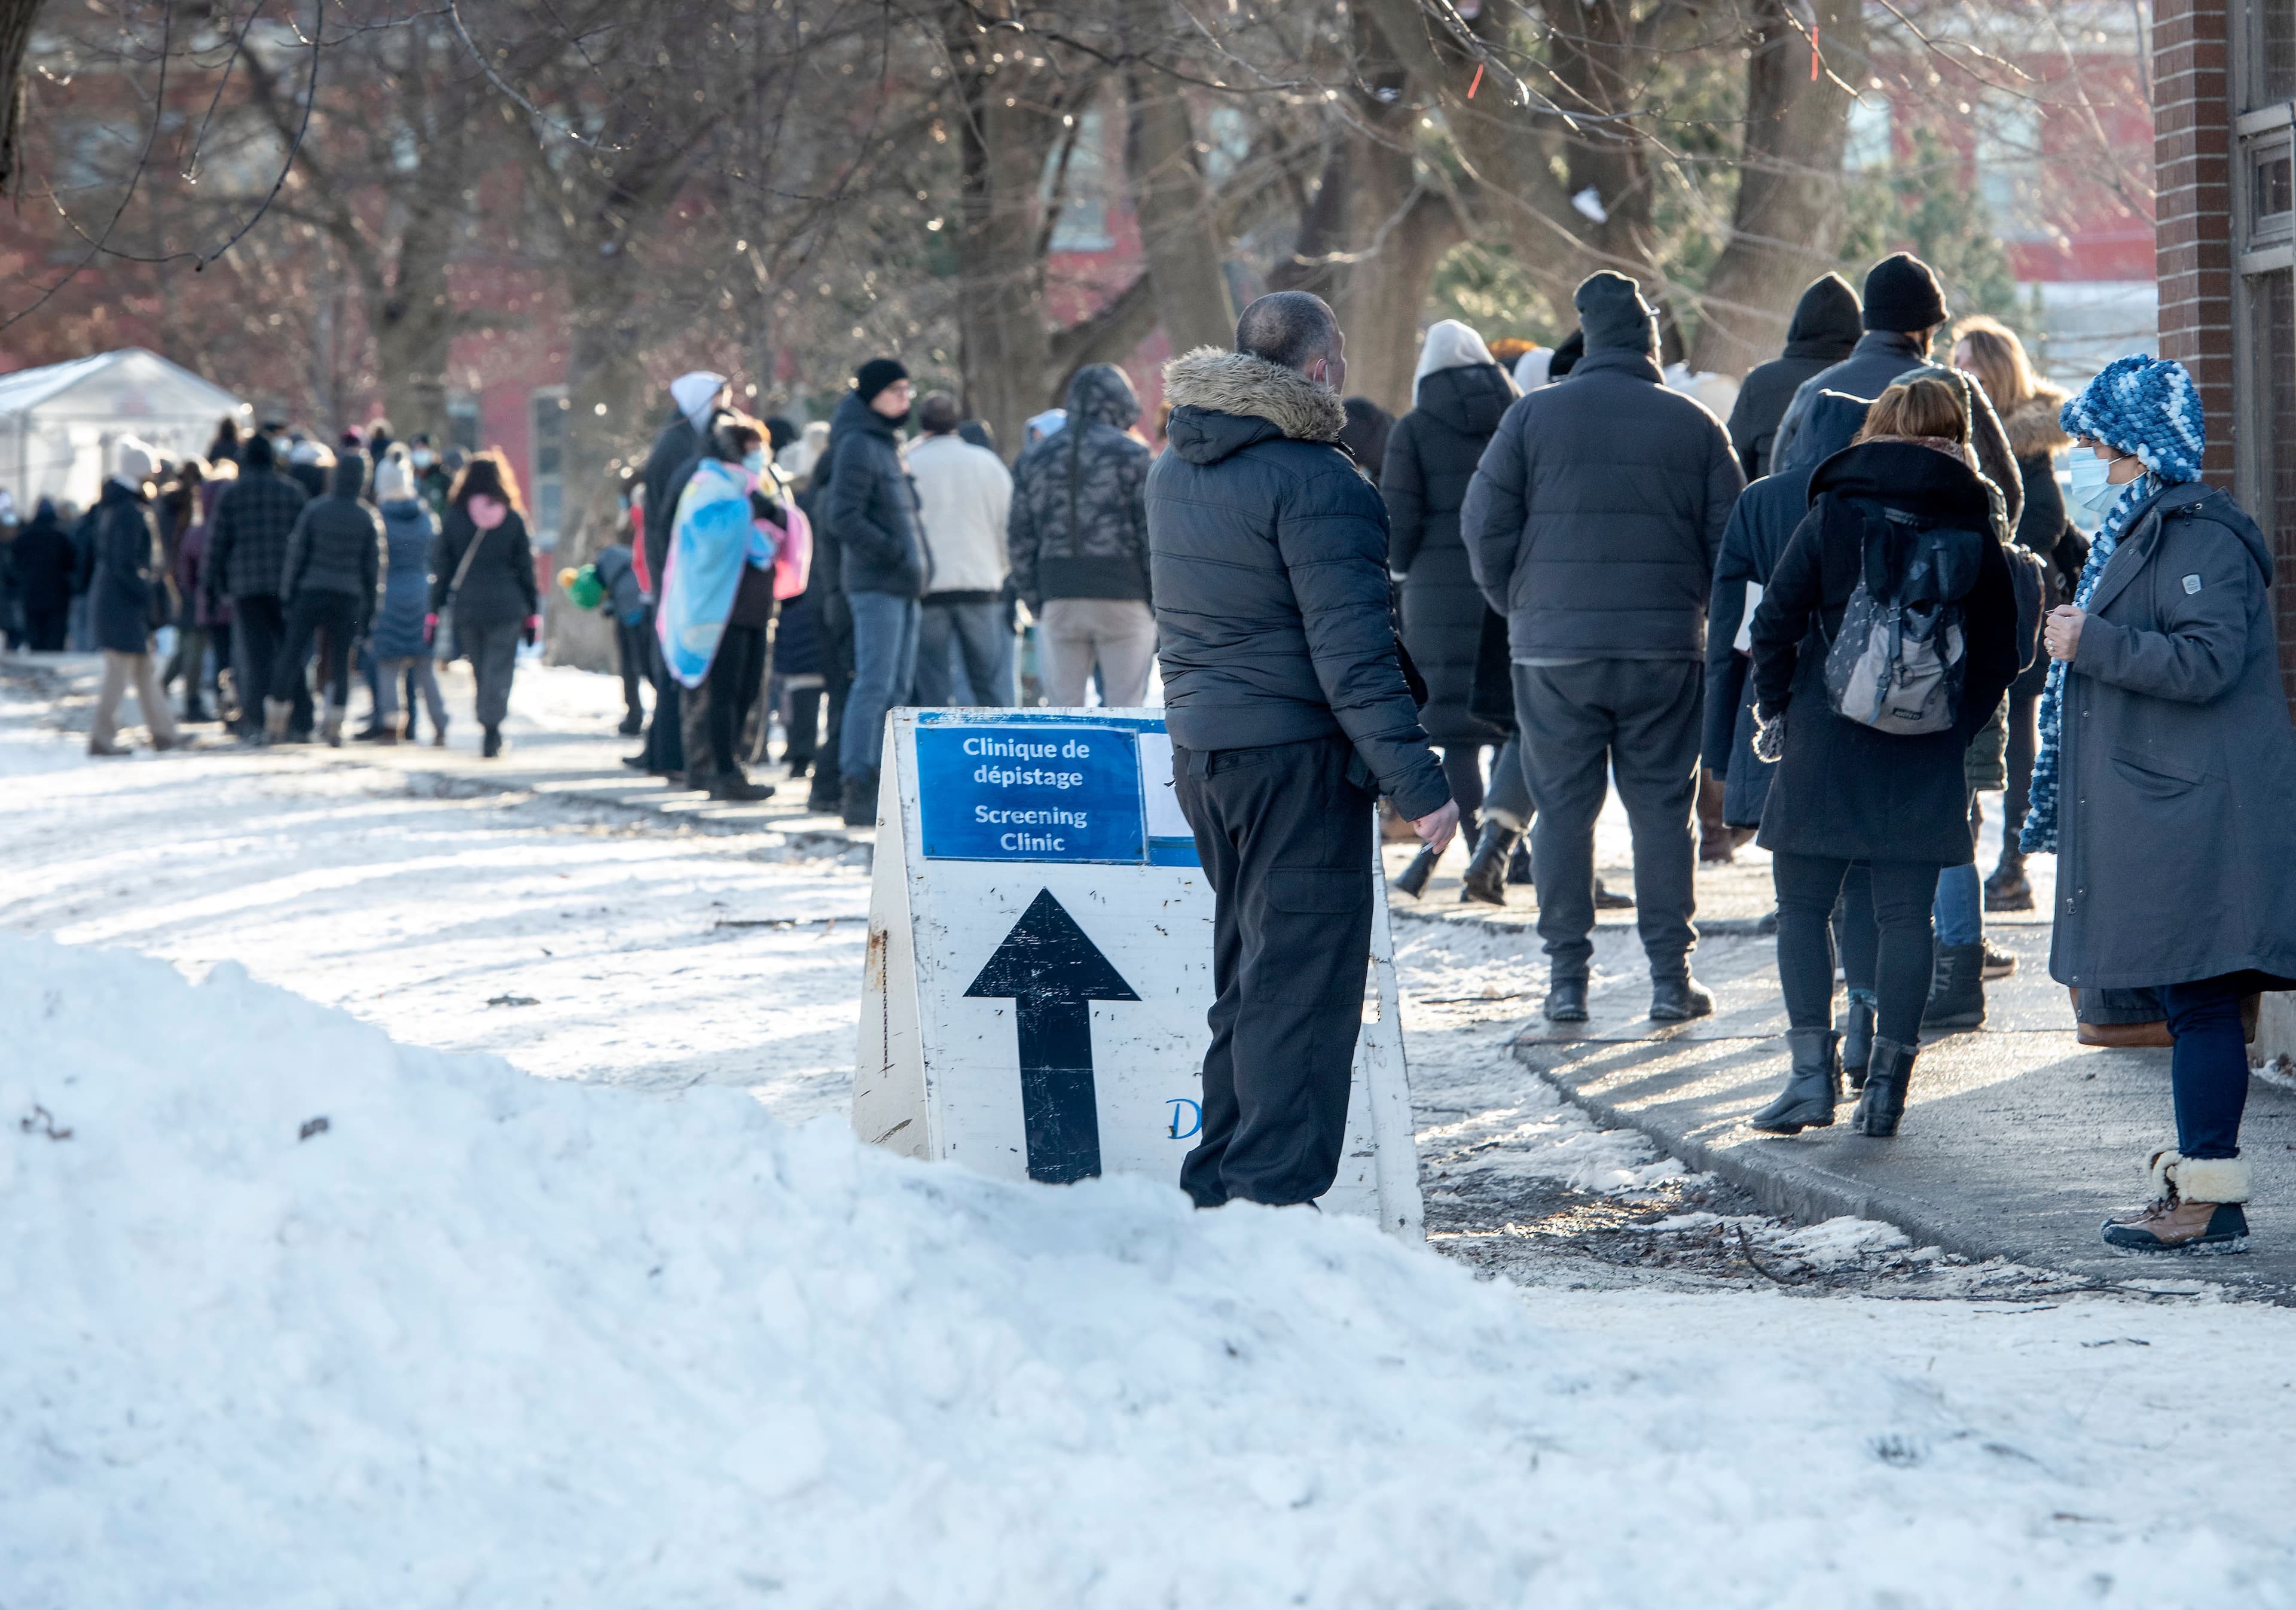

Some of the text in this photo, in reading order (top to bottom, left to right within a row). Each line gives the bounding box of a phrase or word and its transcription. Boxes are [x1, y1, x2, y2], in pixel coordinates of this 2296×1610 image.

[963, 737, 1089, 761] Clinique de
[974, 765, 1083, 789] dépistage
[975, 805, 1087, 828] Screening
[1001, 833, 1065, 852] Clinic
